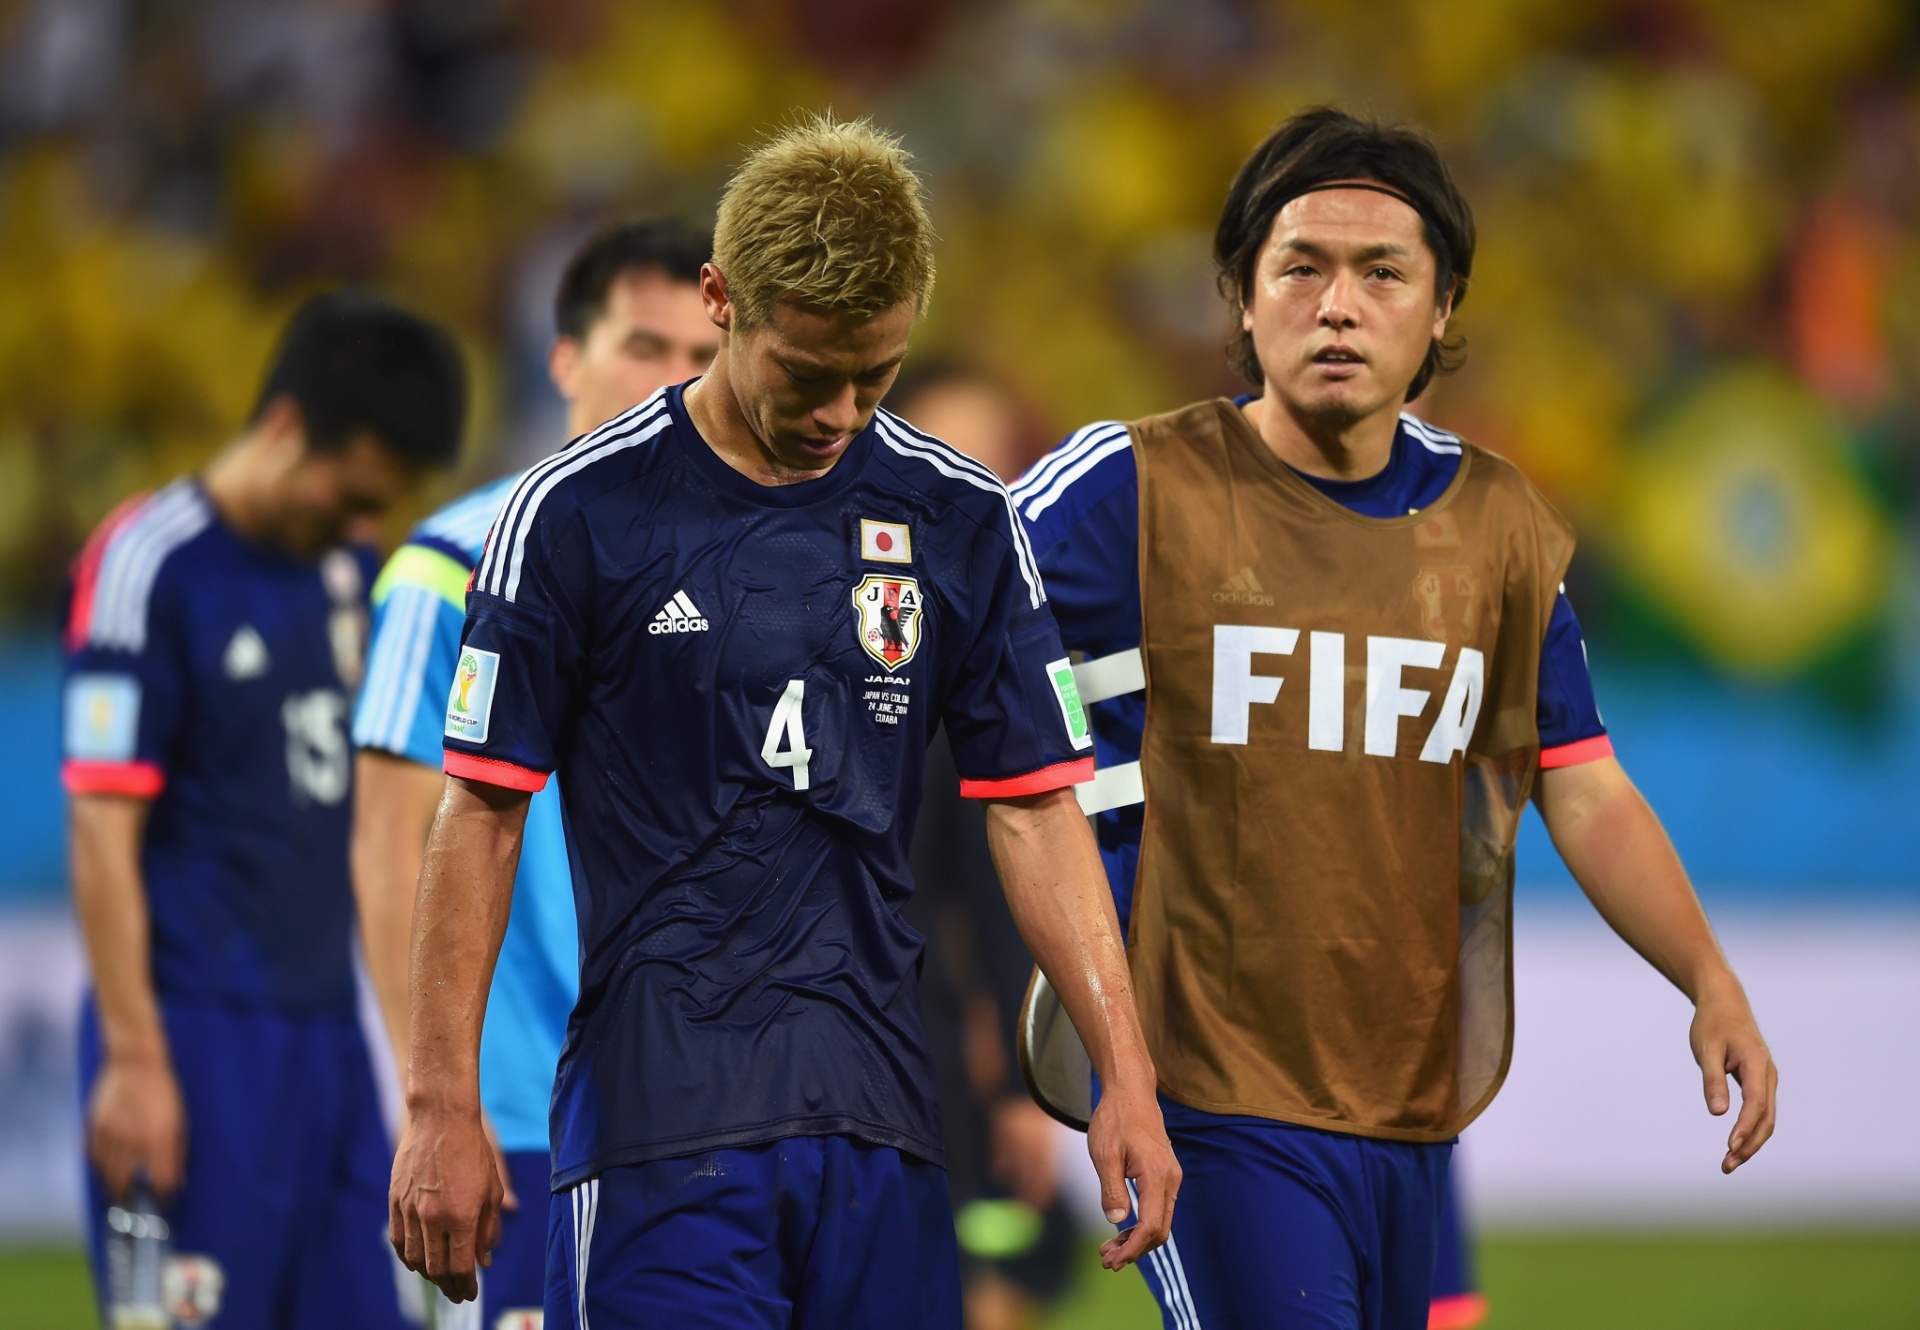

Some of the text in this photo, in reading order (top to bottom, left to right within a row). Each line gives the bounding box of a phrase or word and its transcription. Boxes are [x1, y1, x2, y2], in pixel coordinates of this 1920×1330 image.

[1212, 591, 1275, 607] adidas
[648, 616, 709, 635] adidas
[862, 691, 880, 700] JAPAN
[881, 691, 890, 701] VS
[1210, 624, 1485, 765] FIFA
[467, 718, 478, 726] CUP
[760, 679, 813, 791] 4
